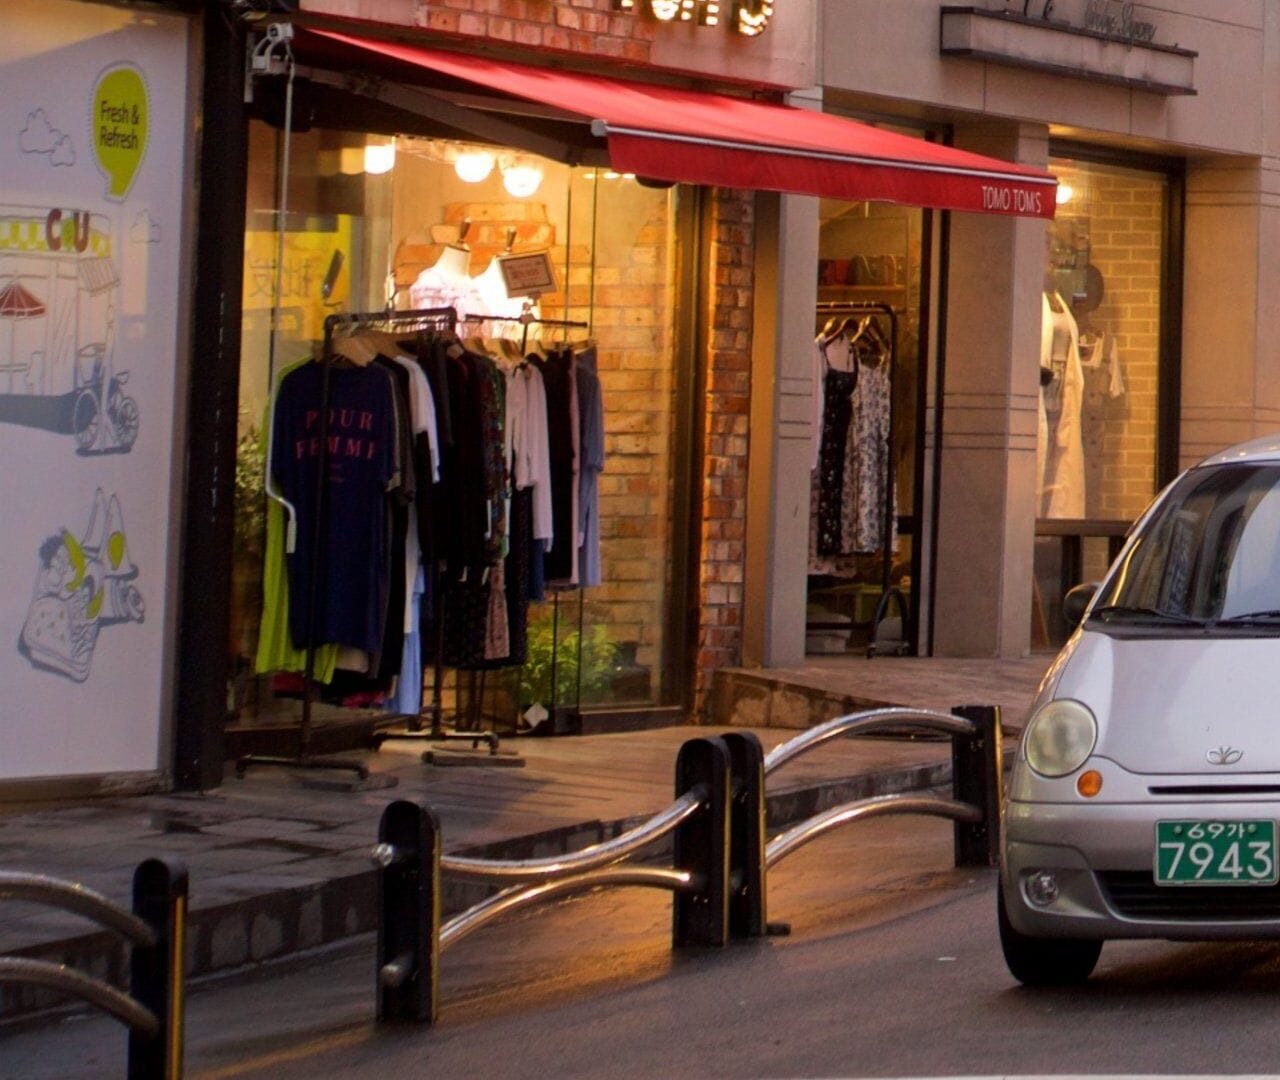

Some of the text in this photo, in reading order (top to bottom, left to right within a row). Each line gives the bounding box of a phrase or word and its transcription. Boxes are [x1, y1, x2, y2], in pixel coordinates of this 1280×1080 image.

[101, 100, 140, 125] Fresh &
[100, 125, 138, 150] Refresh
[982, 185, 1042, 215] TOMO TOM'S
[46, 208, 90, 253] CU
[1187, 823, 1245, 839] 69가
[1159, 840, 1273, 880] 7943
